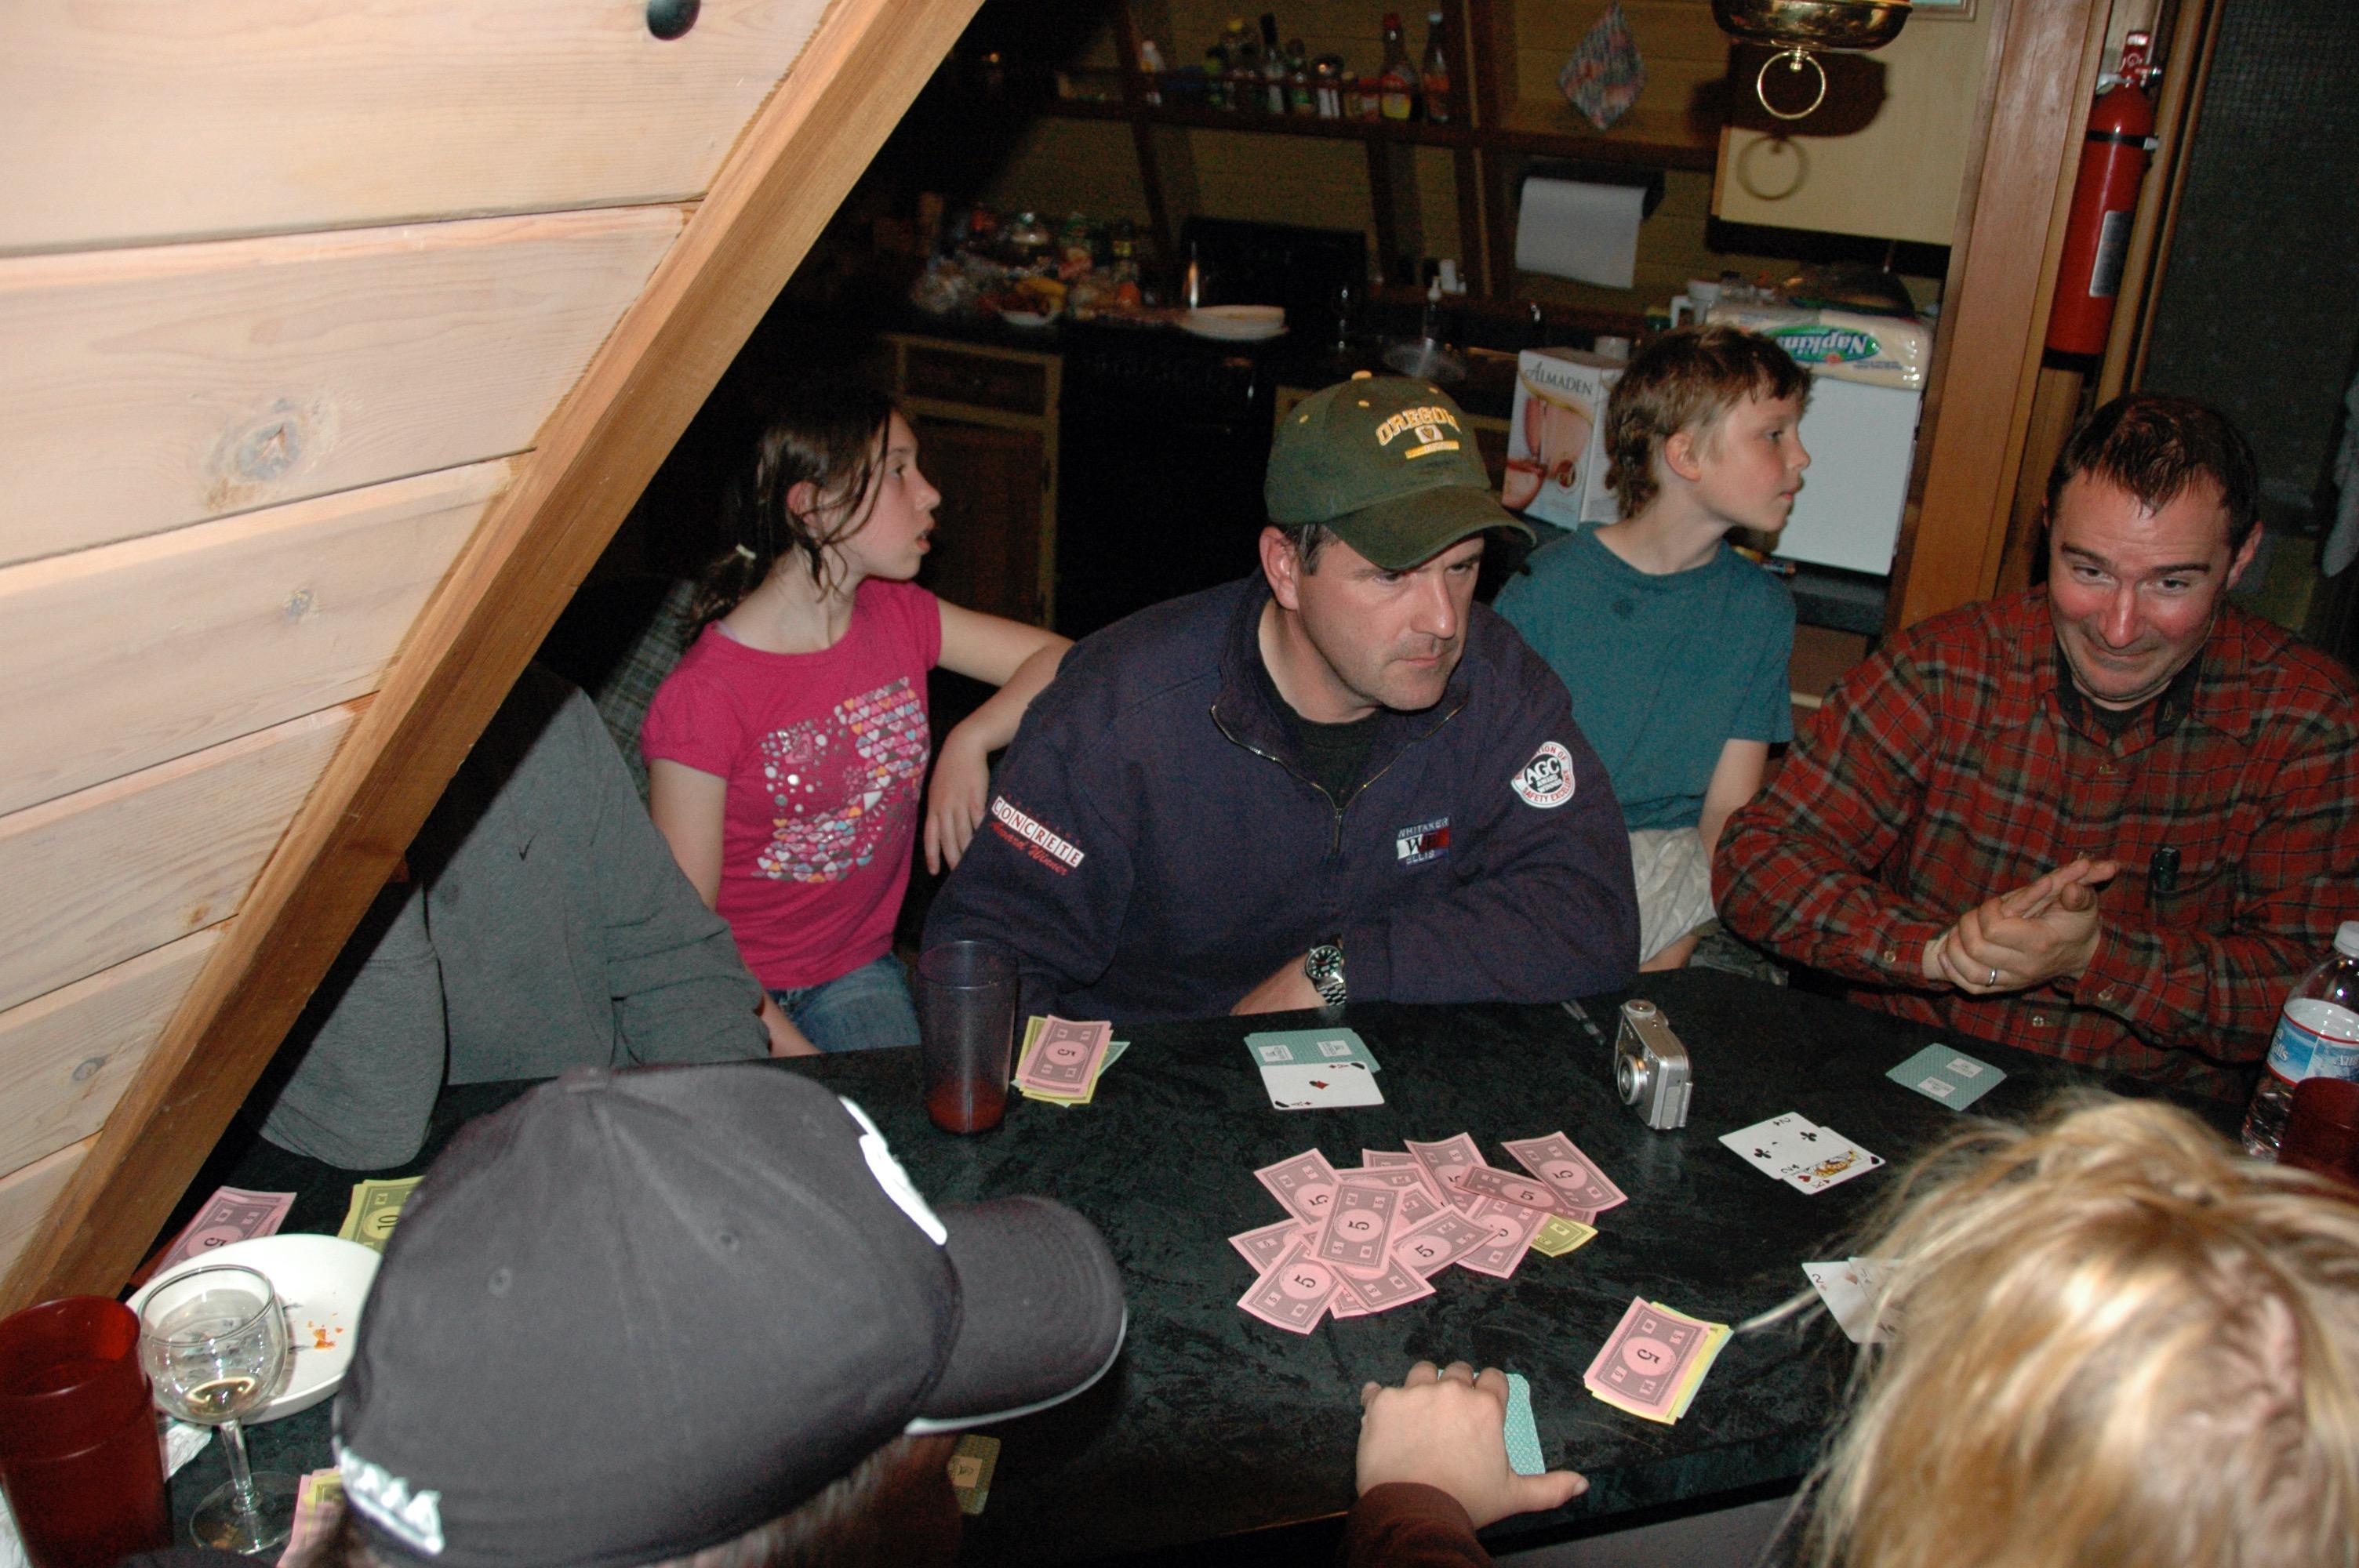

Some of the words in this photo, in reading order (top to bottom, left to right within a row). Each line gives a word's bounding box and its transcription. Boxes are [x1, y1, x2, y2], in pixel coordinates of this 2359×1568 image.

[1376, 406, 1462, 446] OREGON
[1526, 757, 1560, 785] AGC
[1523, 786, 1549, 802] SAFETY
[994, 799, 1081, 866] CONCRETE
[1406, 849, 1435, 865] ELLIS
[1057, 1048, 1077, 1057] 5
[1551, 1170, 1574, 1180] 5
[1308, 1193, 1329, 1206] 5
[1520, 1189, 1535, 1201] 5
[376, 1214, 399, 1231] 10
[1348, 1220, 1371, 1231] 5
[204, 1238, 227, 1247] 5
[1414, 1243, 1435, 1258] 5
[1293, 1273, 1317, 1289] 5
[1812, 1272, 1825, 1284] 2
[1637, 1348, 1661, 1364] 5
